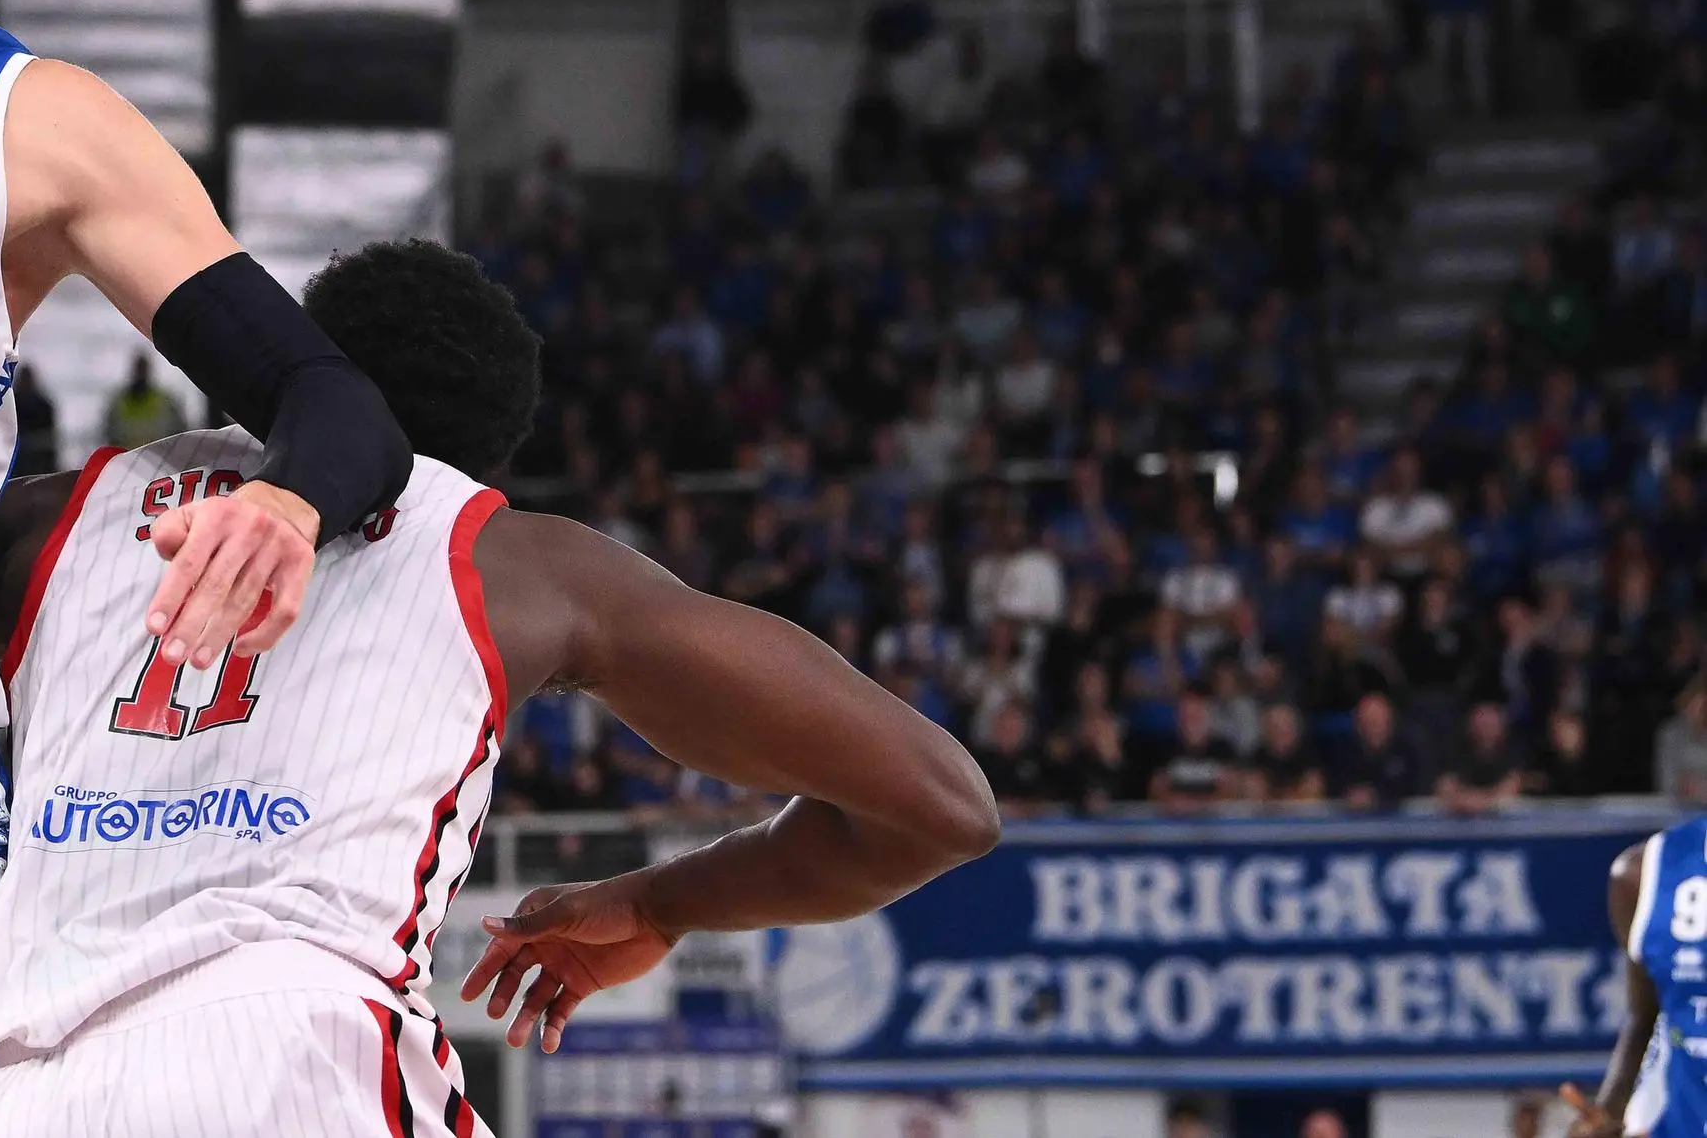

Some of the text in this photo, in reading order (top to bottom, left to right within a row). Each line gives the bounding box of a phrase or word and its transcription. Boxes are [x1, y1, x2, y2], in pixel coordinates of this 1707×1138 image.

[54, 785, 117, 802] GRUPPO
[235, 829, 261, 843] SPA
[1031, 852, 1541, 942] BRIGATA
